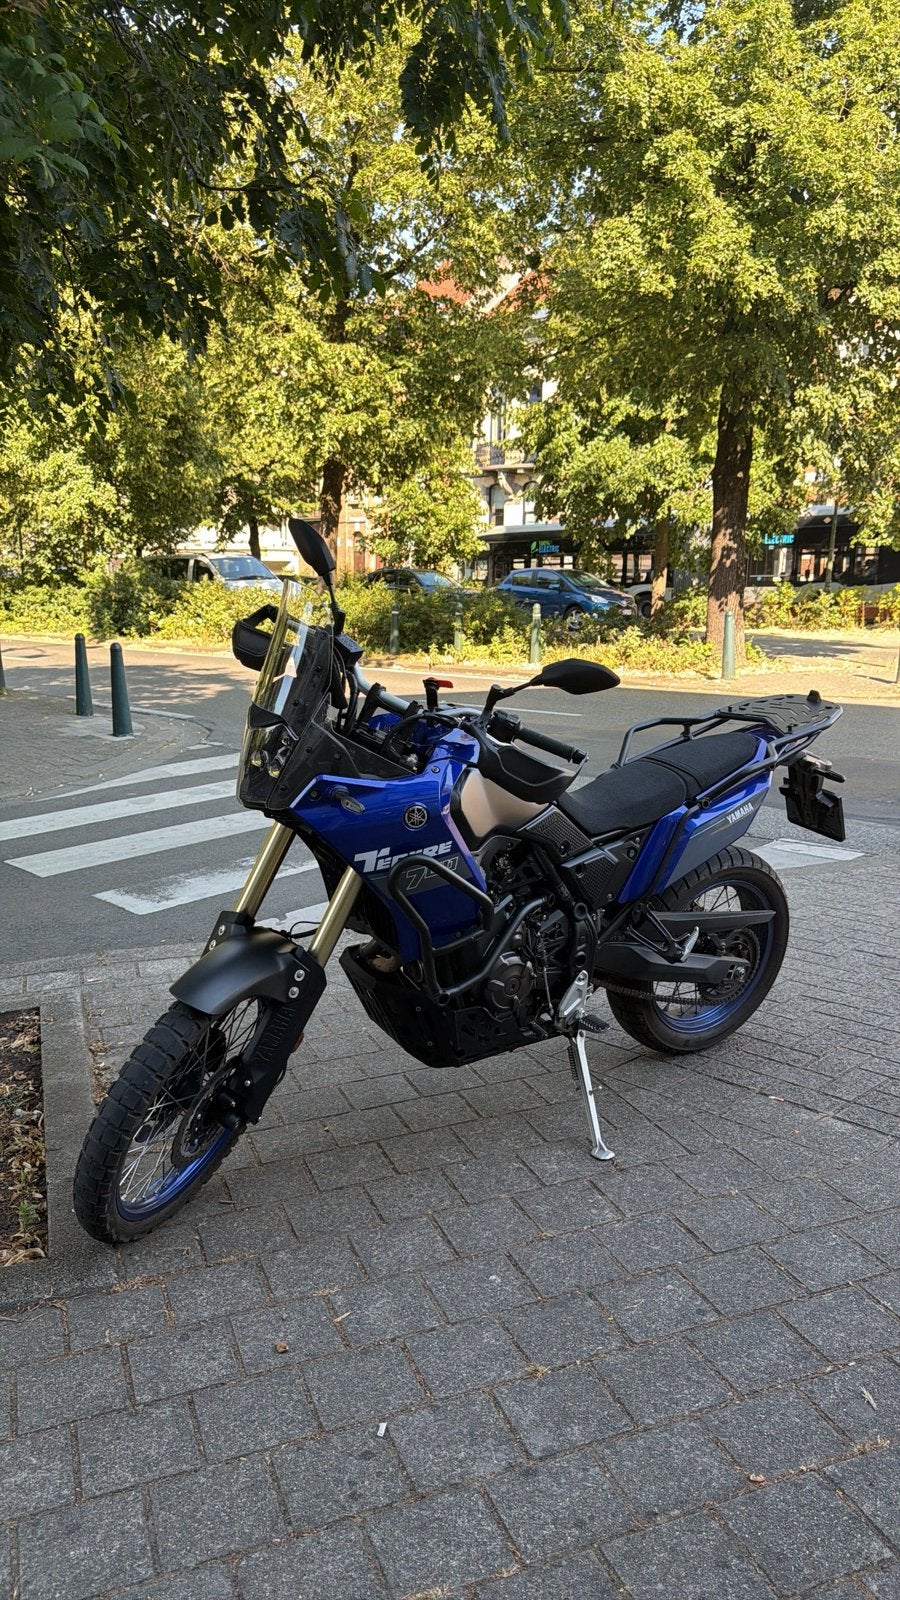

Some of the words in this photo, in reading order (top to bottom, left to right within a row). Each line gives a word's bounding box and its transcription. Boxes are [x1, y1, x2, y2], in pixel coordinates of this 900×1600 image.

[538, 545, 560, 554] ELECTRIC
[726, 802, 754, 824] YAMAHA
[253, 1006, 297, 1063] YAMAHA
